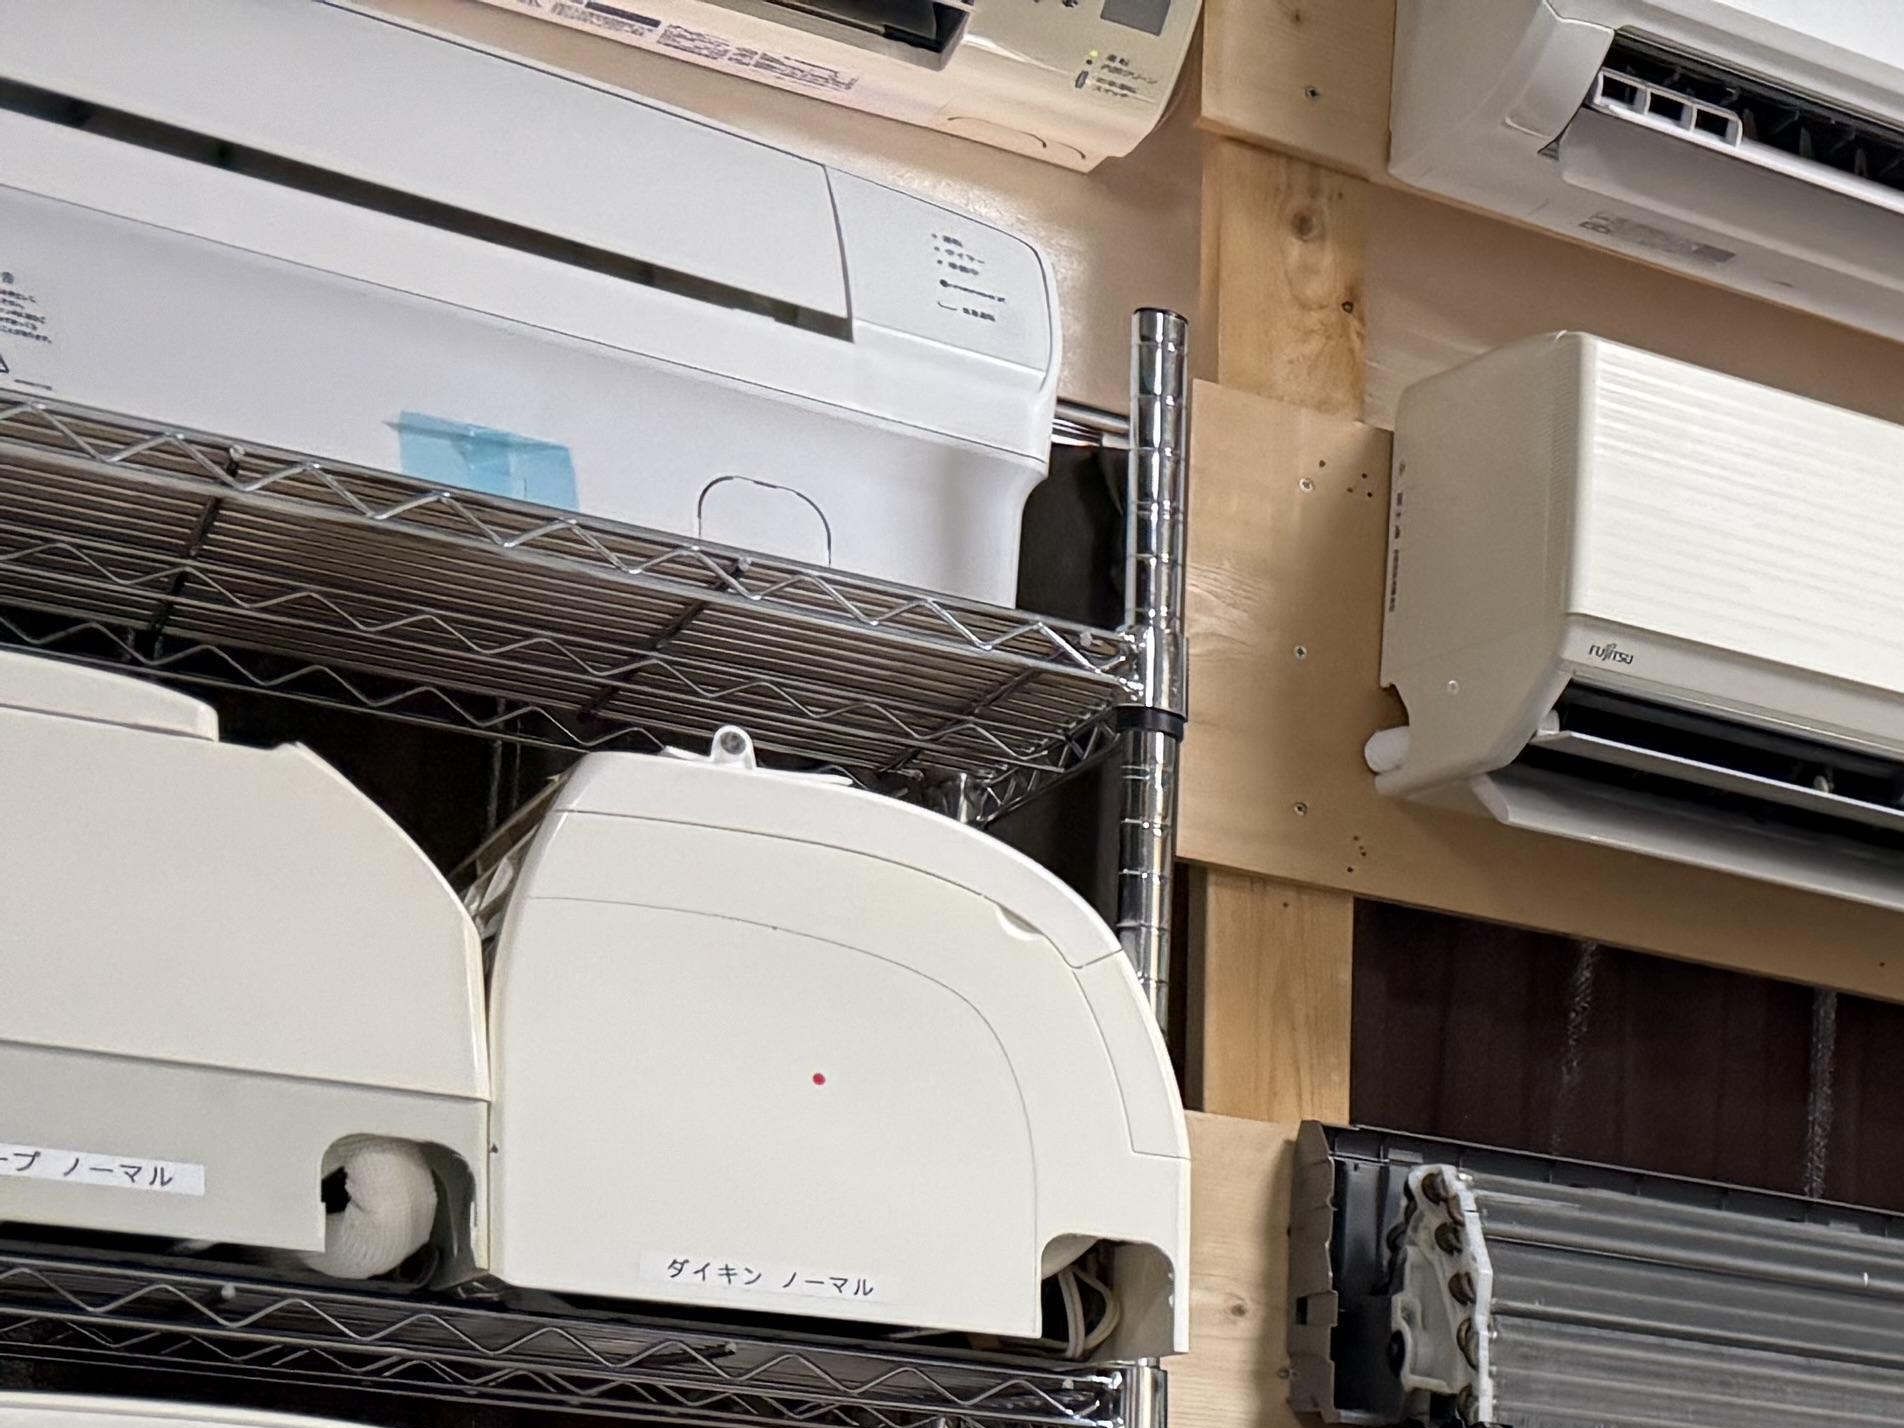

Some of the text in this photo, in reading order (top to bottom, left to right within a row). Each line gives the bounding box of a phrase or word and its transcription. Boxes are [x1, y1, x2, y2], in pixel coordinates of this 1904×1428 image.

[1588, 642, 1634, 665] FUJITSU
[63, 1157, 173, 1187] ノーマル
[667, 1258, 874, 1297] ダイキン ノーマル
